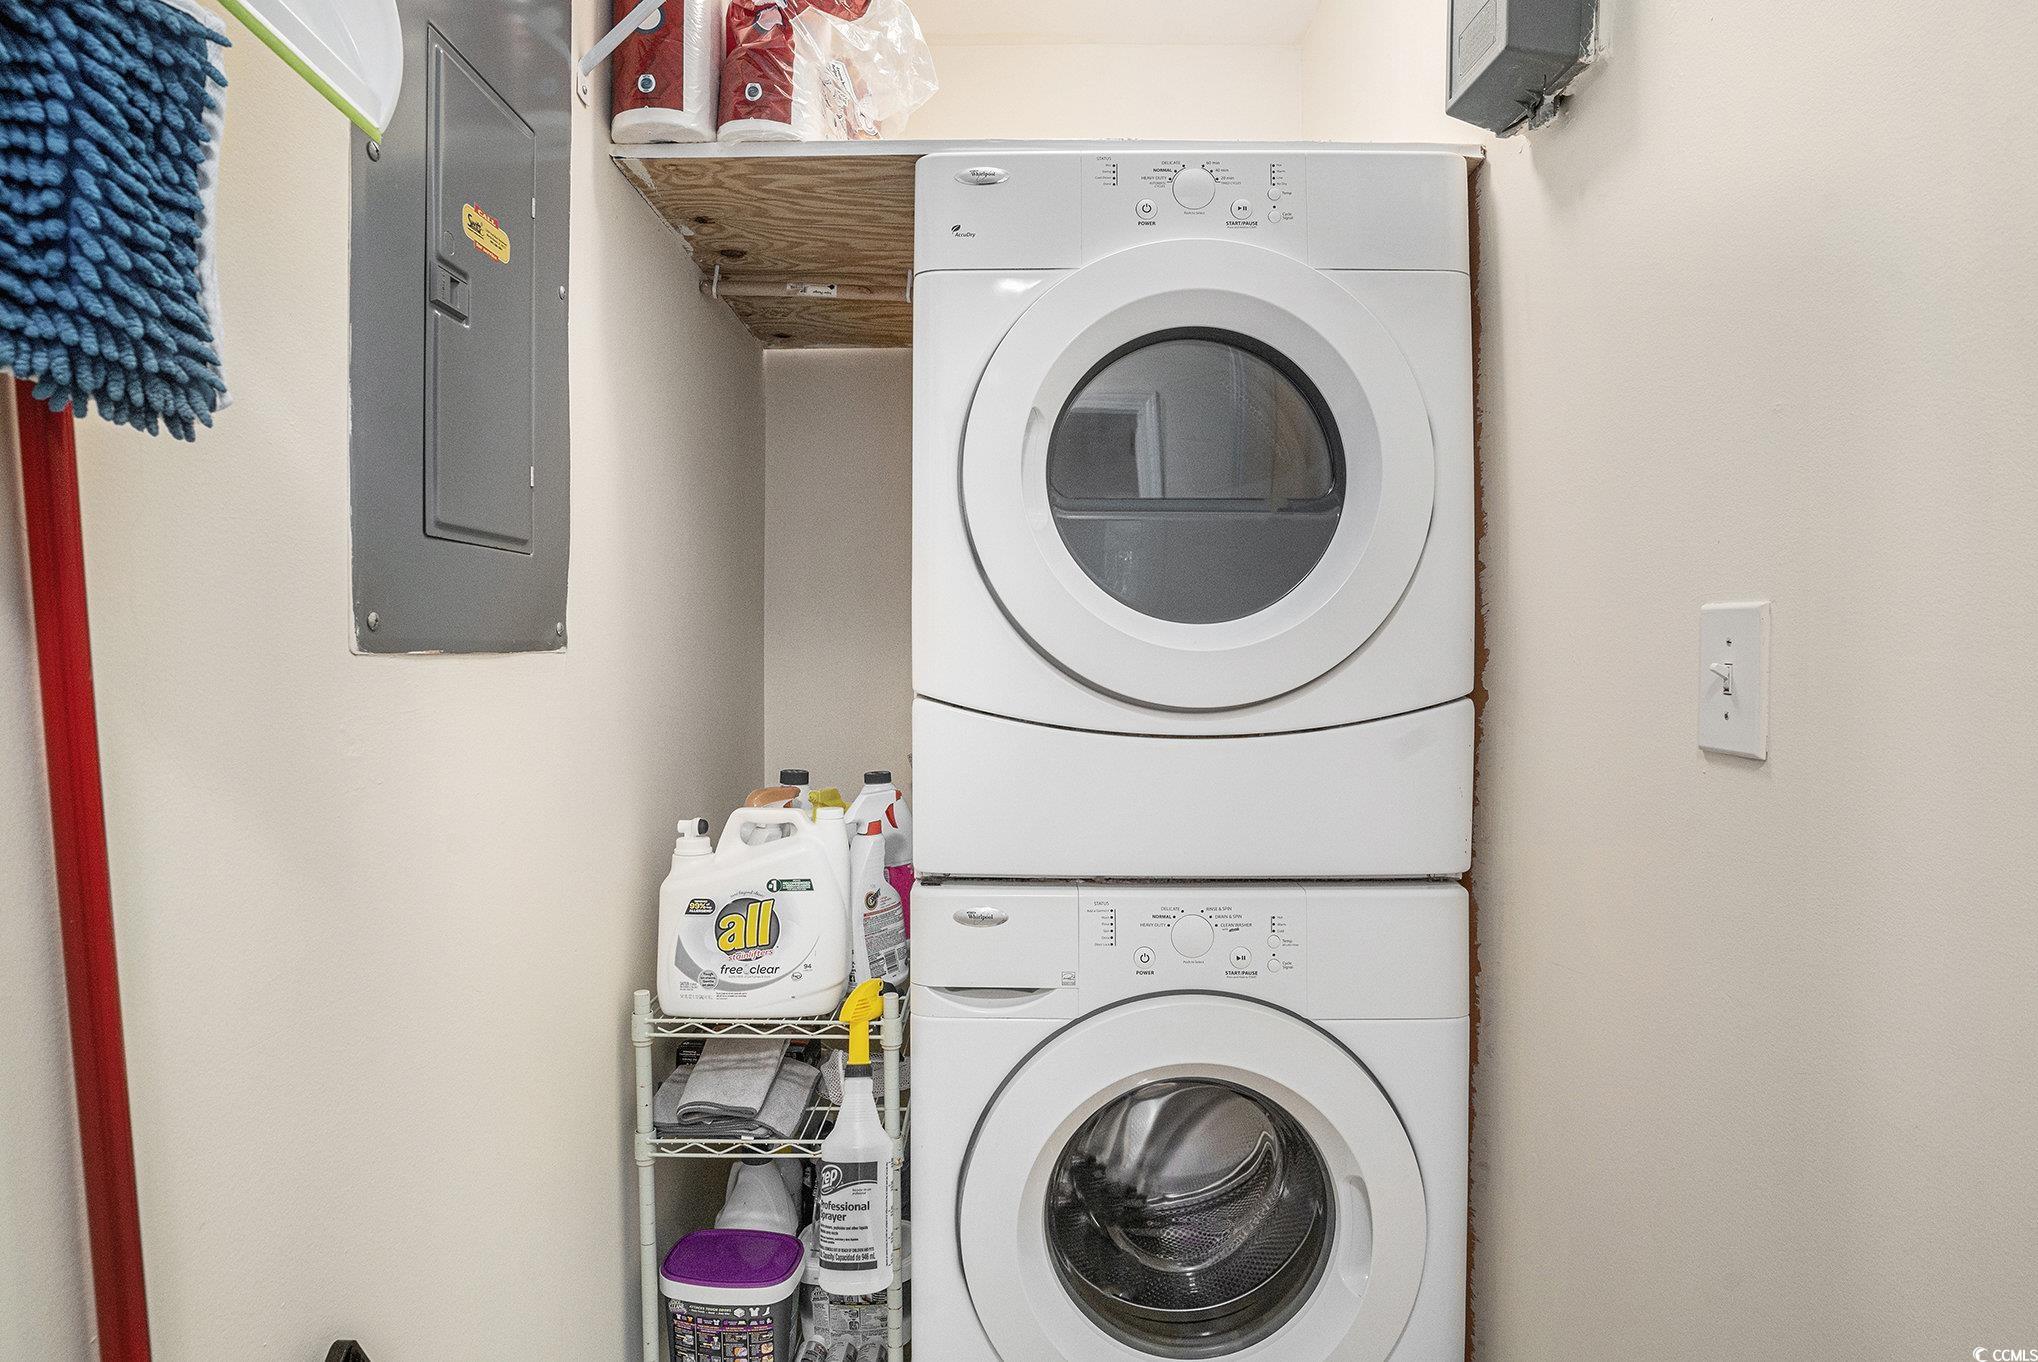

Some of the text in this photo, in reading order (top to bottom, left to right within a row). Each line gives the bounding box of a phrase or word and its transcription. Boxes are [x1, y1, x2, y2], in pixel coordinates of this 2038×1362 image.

[718, 899, 775, 952] all
[728, 949, 773, 961] stainlifters
[720, 964, 780, 975] free clear
